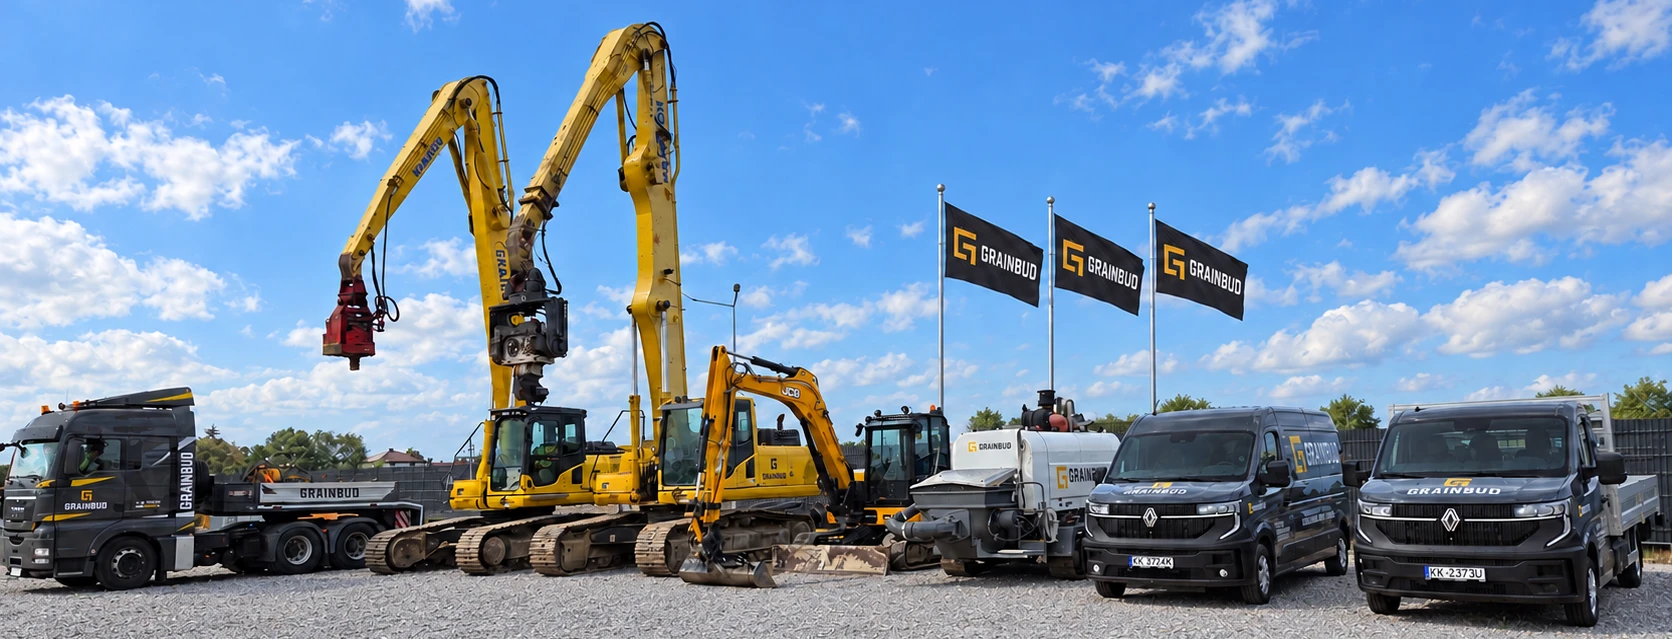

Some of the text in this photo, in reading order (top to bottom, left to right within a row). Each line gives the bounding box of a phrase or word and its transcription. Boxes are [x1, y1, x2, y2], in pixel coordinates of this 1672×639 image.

[981, 245, 1037, 281] GRAINBUD
[1087, 254, 1139, 290] GRAINBUD
[1189, 259, 1242, 295] GRAINBUD
[782, 386, 801, 399] JCB
[179, 451, 194, 511] GRAINBUD
[299, 487, 360, 499] GRAINBUD
[1406, 487, 1502, 495] GRAINBUD
[64, 502, 108, 511] GRAINBUD
[1133, 558, 1145, 567] KK
[1429, 568, 1483, 579] KK 2373U
